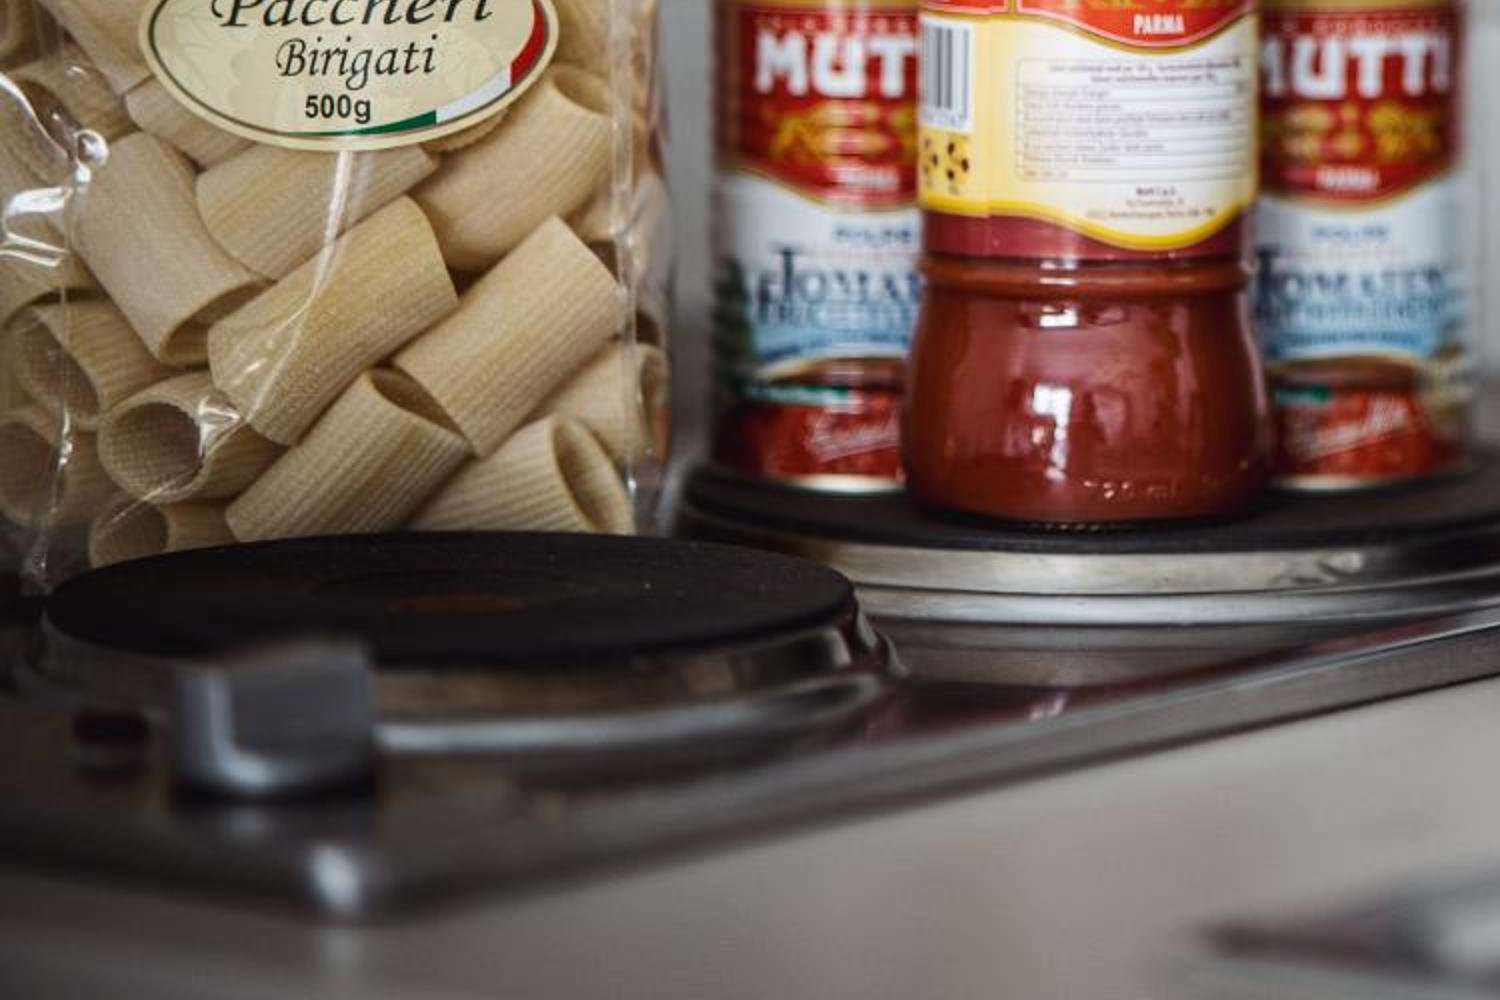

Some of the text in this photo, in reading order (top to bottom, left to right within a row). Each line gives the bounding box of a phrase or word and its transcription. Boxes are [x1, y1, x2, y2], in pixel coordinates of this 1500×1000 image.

[1132, 13, 1186, 36] PARMA
[274, 31, 439, 91] Birigati
[753, 28, 917, 98] MUT
[303, 93, 373, 125] 500g
